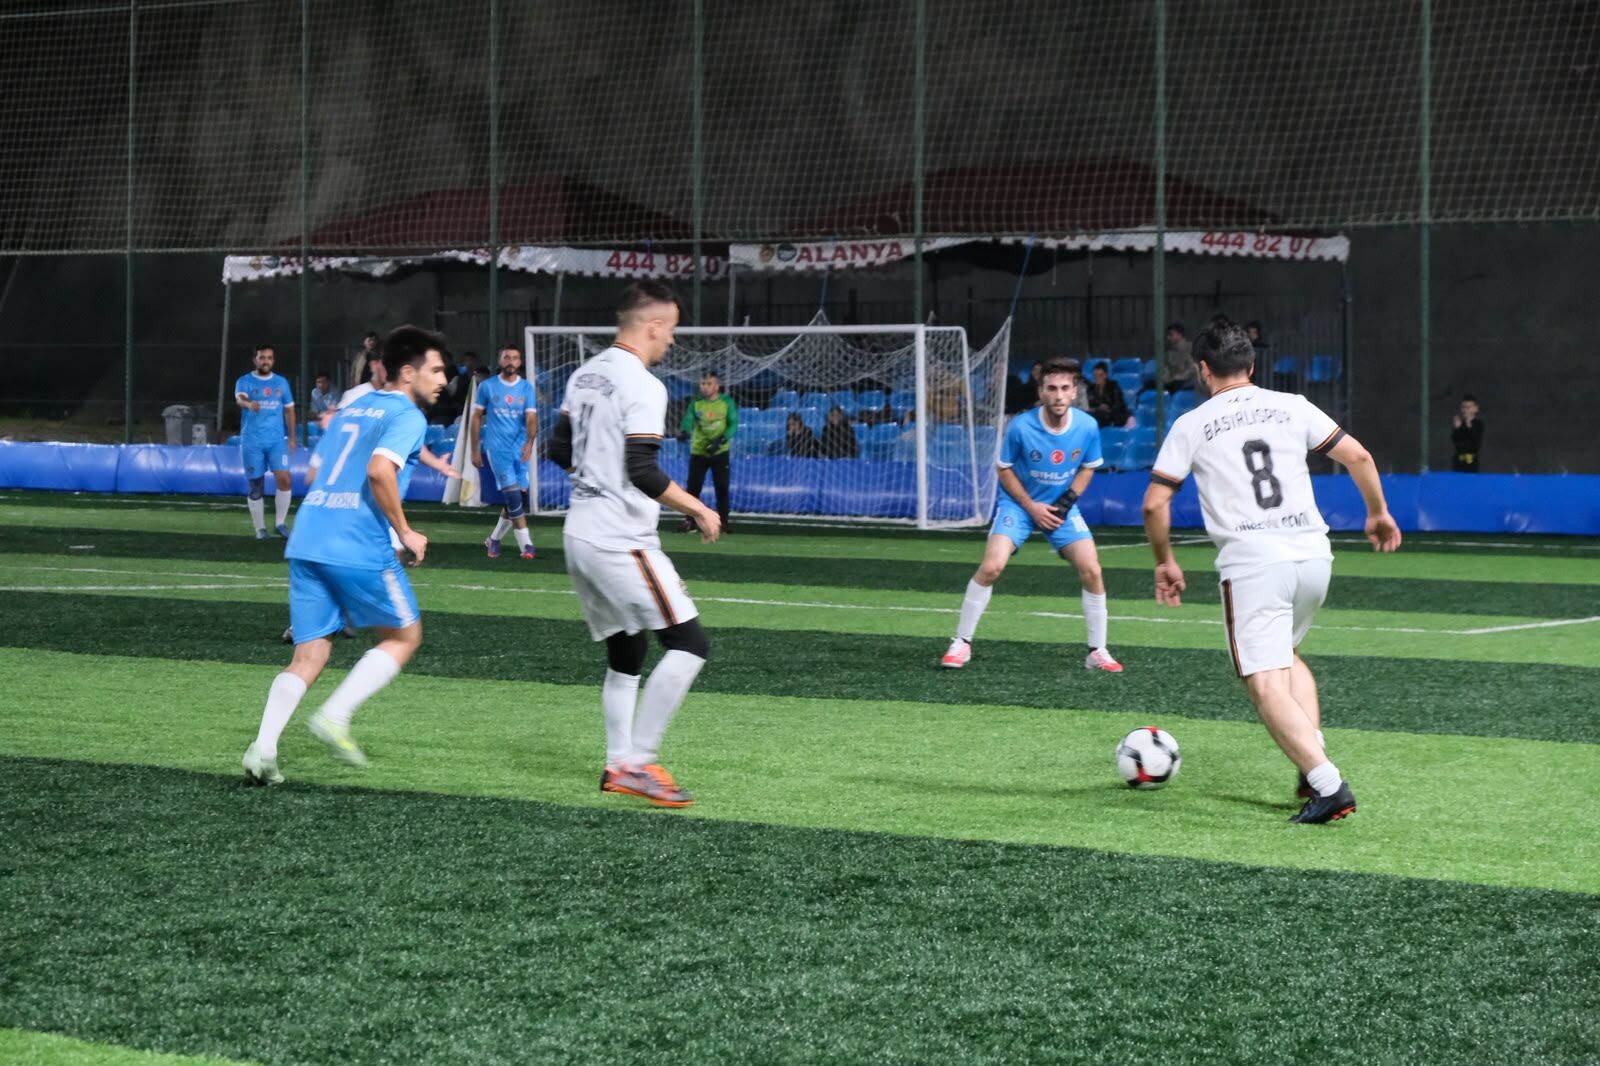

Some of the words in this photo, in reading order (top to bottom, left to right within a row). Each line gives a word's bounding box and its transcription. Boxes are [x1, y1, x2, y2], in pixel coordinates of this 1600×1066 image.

[796, 241, 904, 262] ALANYA
[1201, 229, 1246, 250] 444
[1252, 232, 1282, 252] 82
[1289, 236, 1317, 253] 07
[606, 249, 655, 271] 444
[665, 254, 695, 275] 82
[326, 423, 360, 486] 7
[1241, 438, 1284, 511] 8
